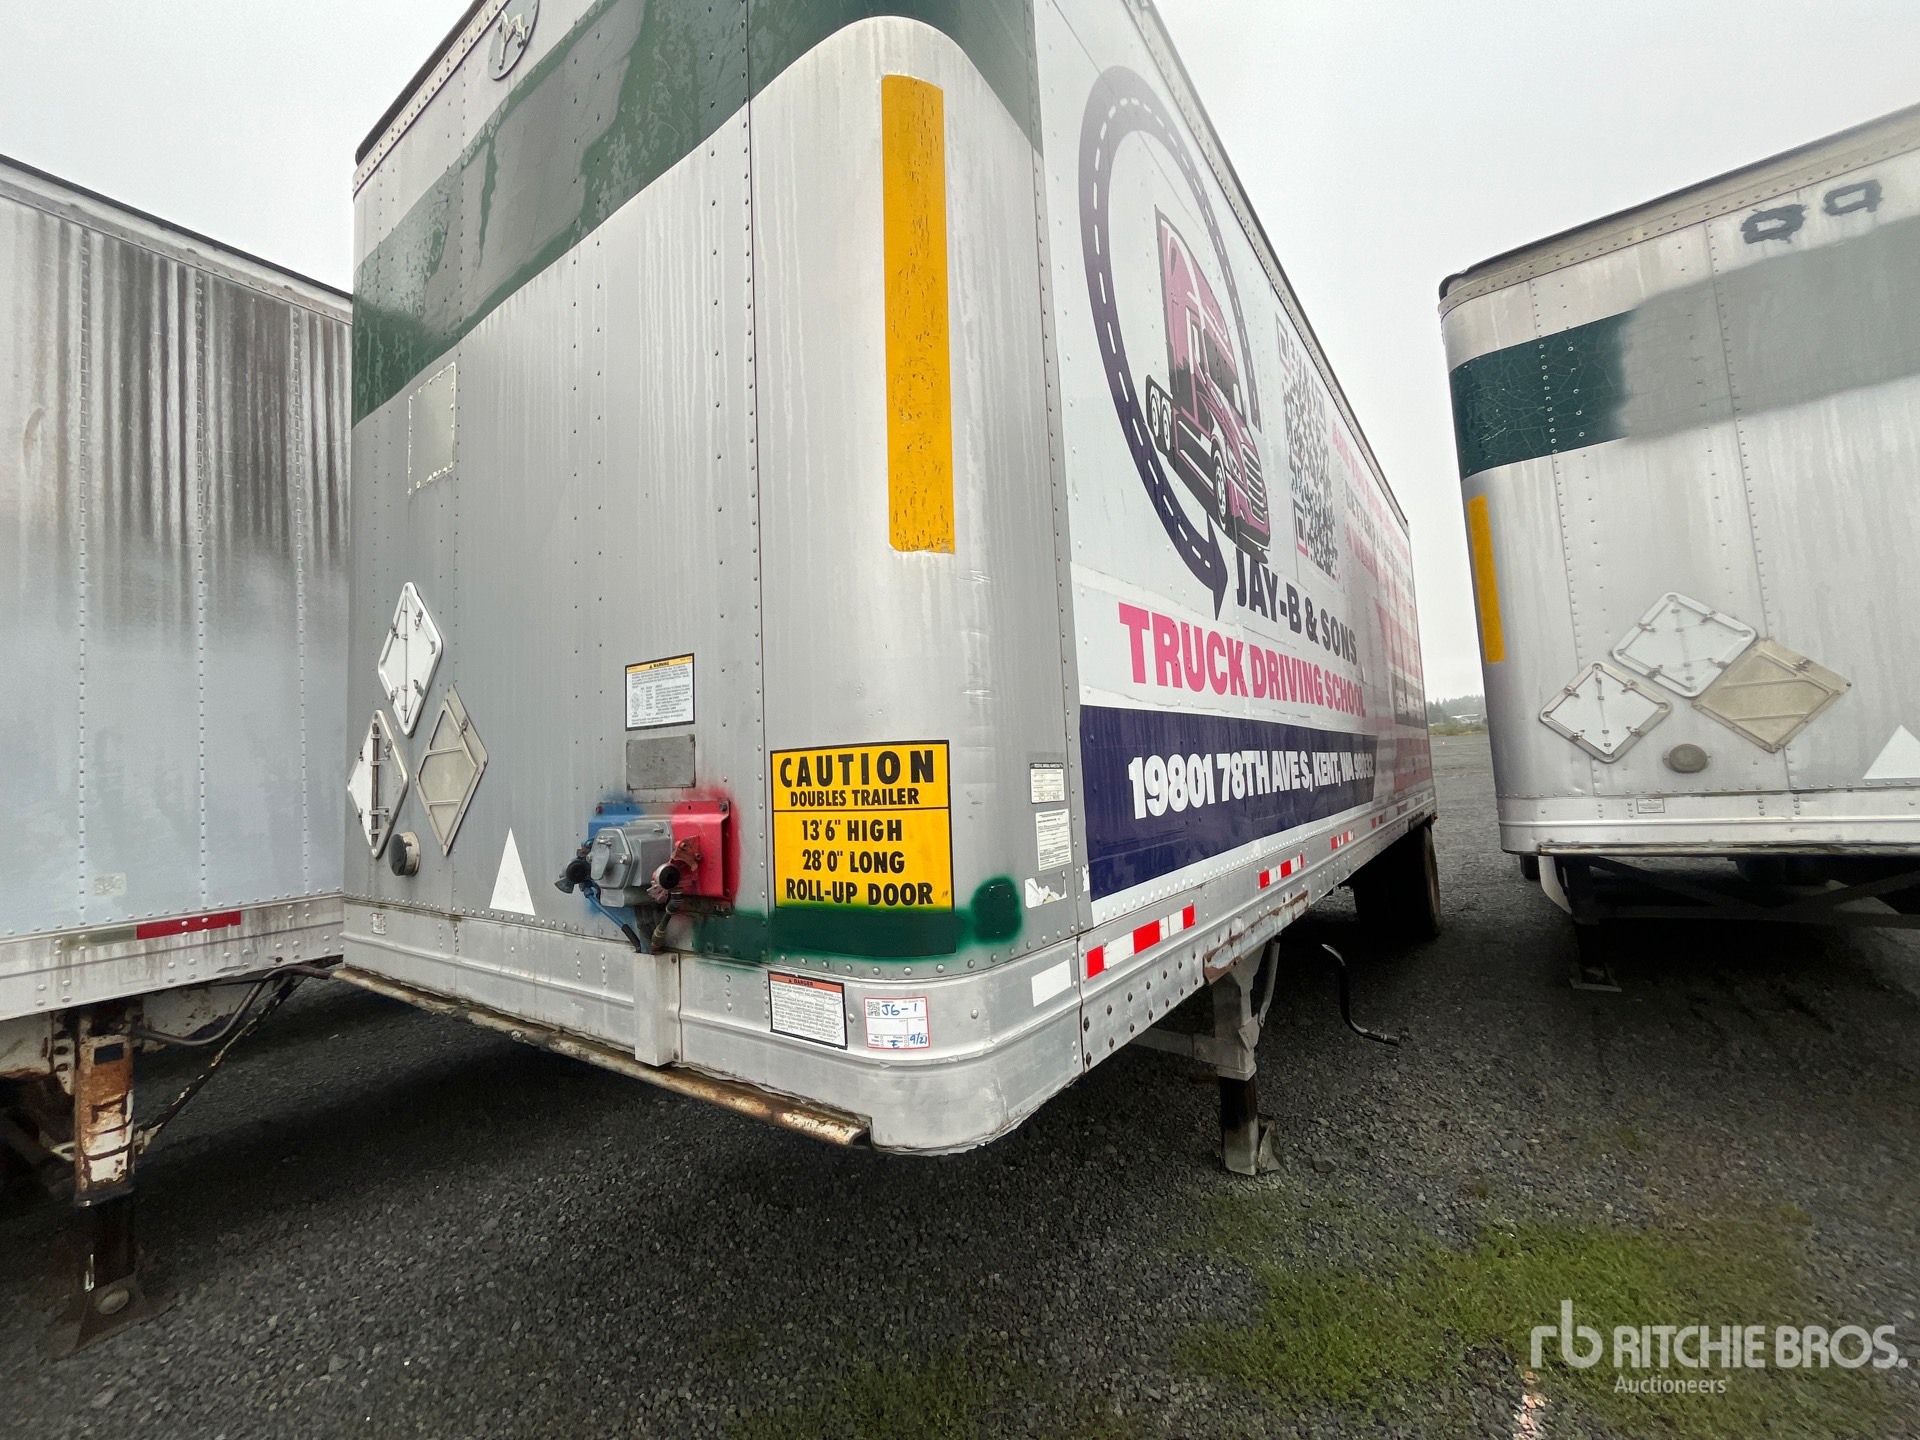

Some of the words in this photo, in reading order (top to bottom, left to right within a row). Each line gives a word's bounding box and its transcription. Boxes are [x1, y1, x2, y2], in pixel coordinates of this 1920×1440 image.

[1236, 546, 1302, 635] JAY-B
[1305, 596, 1320, 645] &
[1320, 608, 1357, 666] SONS
[1118, 601, 1249, 698] TRUCK
[1249, 643, 1324, 706] DRIVING
[1324, 669, 1367, 718] SCHOOL
[779, 750, 935, 788] CAUTION
[790, 789, 847, 807] DOUBLES
[852, 787, 920, 806] TRAILER
[1128, 753, 1216, 820] 19801
[1216, 750, 1271, 802] 78TH
[1312, 751, 1341, 787] KENT,
[1339, 751, 1355, 782] WA
[847, 819, 903, 842] HIGH
[850, 852, 905, 874] LONG
[786, 878, 858, 904] ROLL-UP
[868, 882, 934, 906] DOOR
[794, 978, 814, 987] DANGER
